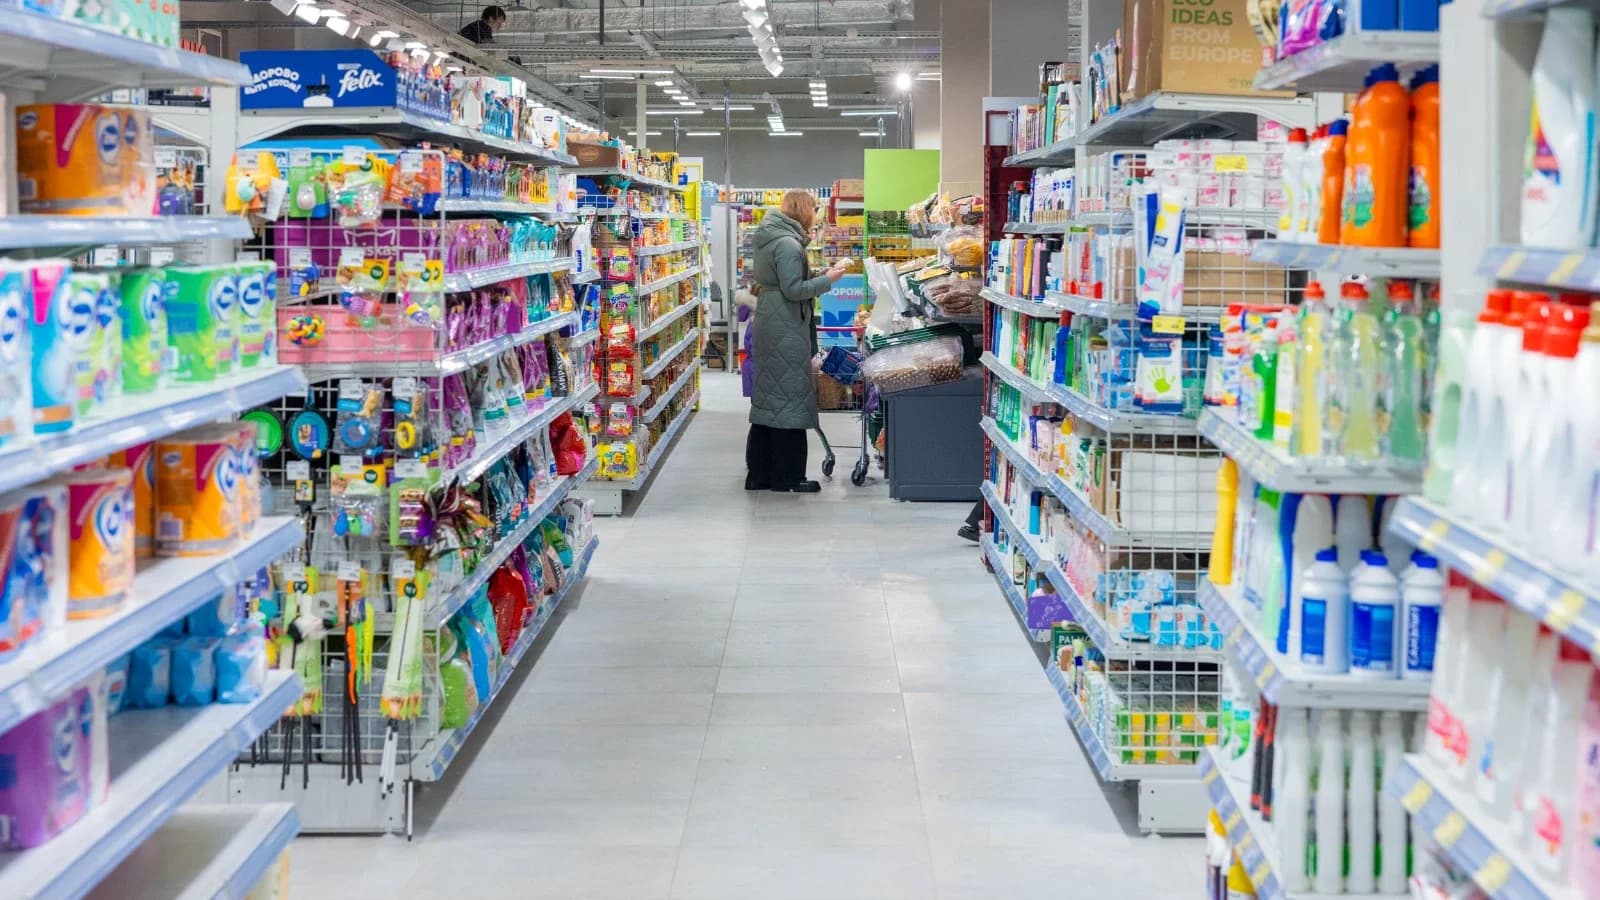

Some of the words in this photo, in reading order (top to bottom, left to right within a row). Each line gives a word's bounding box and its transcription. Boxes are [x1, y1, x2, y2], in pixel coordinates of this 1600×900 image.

[1171, 8, 1233, 26] IDEAS
[1171, 26, 1231, 45] FROM
[1169, 44, 1255, 65] EUROPE
[252, 67, 300, 84] ДОРОВО
